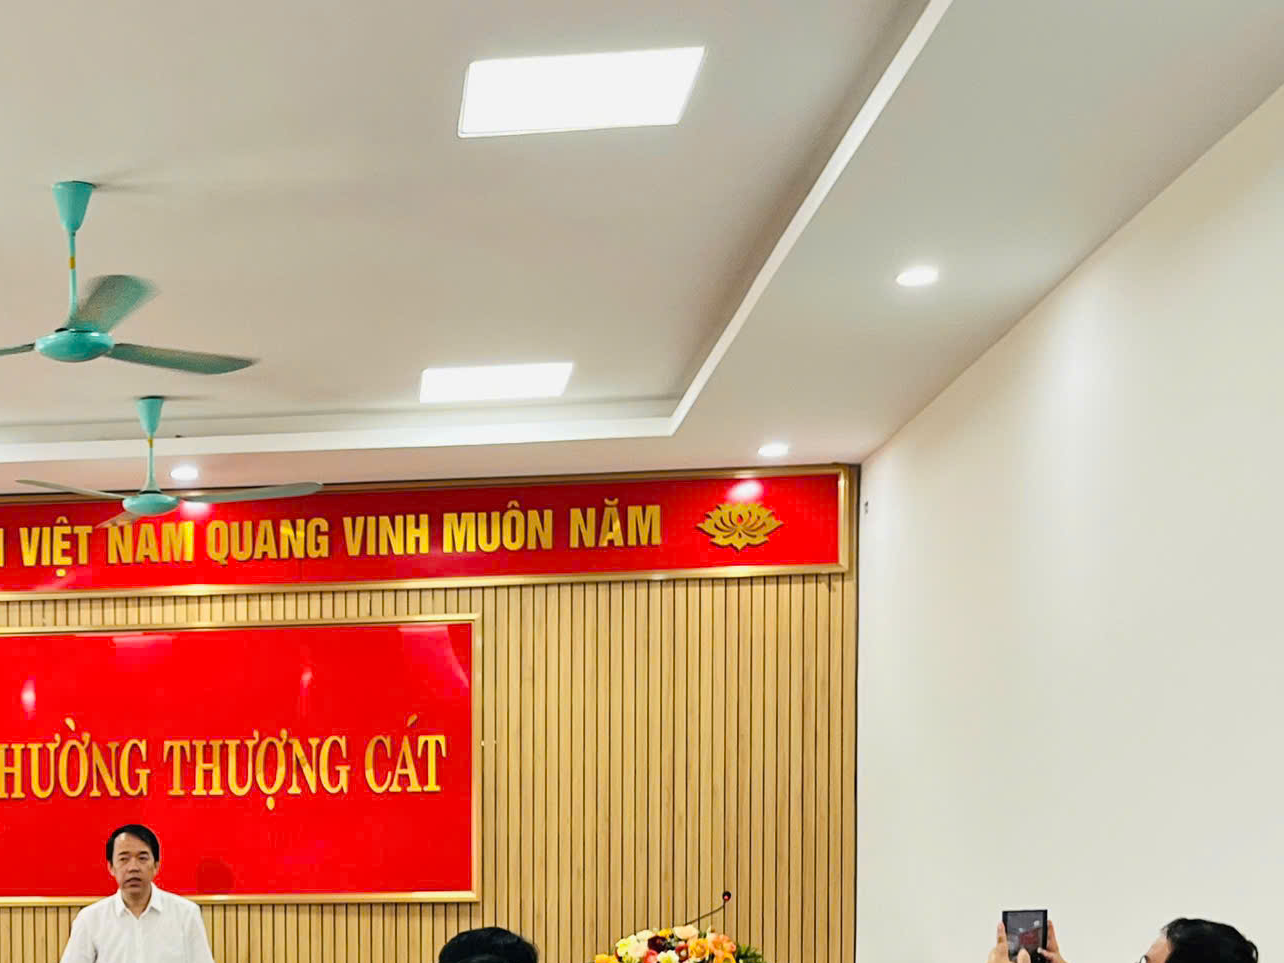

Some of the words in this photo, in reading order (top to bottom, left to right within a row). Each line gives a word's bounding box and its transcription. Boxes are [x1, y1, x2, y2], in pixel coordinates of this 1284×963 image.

[19, 516, 93, 577] VIỆT
[107, 520, 195, 564] NAM
[206, 517, 329, 565] QUANG
[343, 514, 429, 556] VINH
[443, 500, 554, 553] MUÔN
[569, 498, 662, 548] NĂM
[163, 729, 351, 810] THƯỢNG
[365, 713, 447, 793] CÁT
